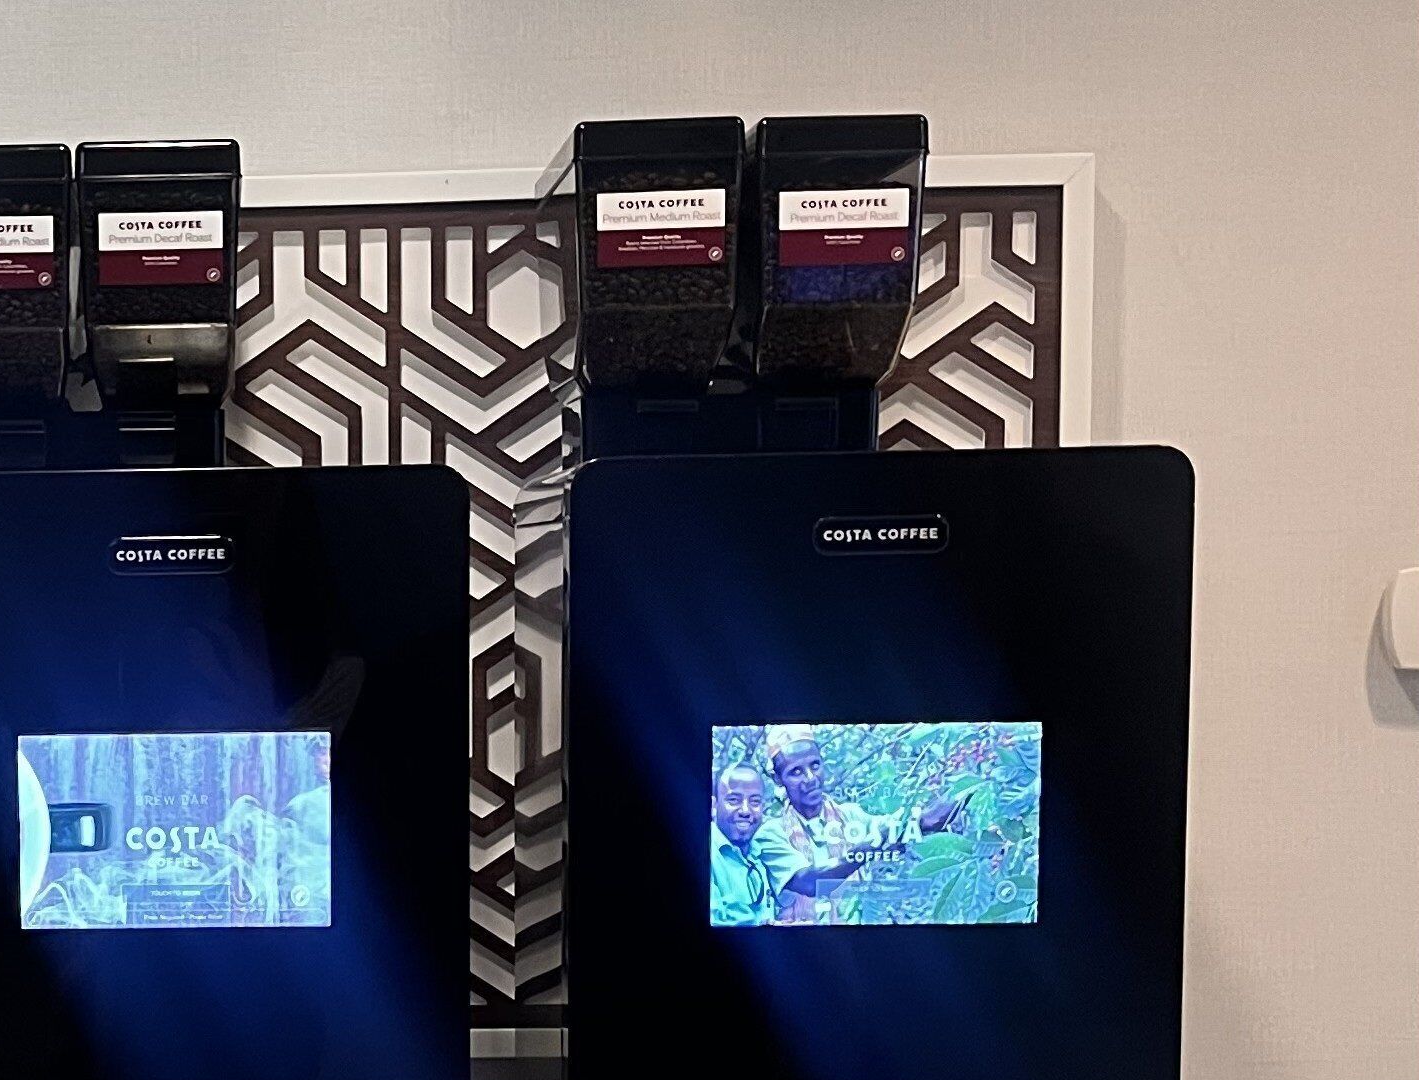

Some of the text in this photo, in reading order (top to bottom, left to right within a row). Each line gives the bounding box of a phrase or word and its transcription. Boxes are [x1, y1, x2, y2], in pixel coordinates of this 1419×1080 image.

[618, 198, 705, 210] COSTA COFFEE
[801, 198, 887, 210] COSTA COFFEE
[602, 210, 721, 224] Premium Medium Roast
[790, 211, 899, 223] Premium Decaf Roast
[118, 220, 202, 231] COSTA COFFEE
[22, 236, 50, 247] Roast
[108, 232, 213, 244] Premium Decaf Roast
[823, 527, 939, 543] COSTA COFFEE
[115, 548, 226, 563] COSTA COFFEE
[125, 825, 221, 854] COSTA
[824, 820, 922, 848] COSTA
[148, 856, 199, 868] COFFEE
[846, 850, 901, 863] COFFEE
